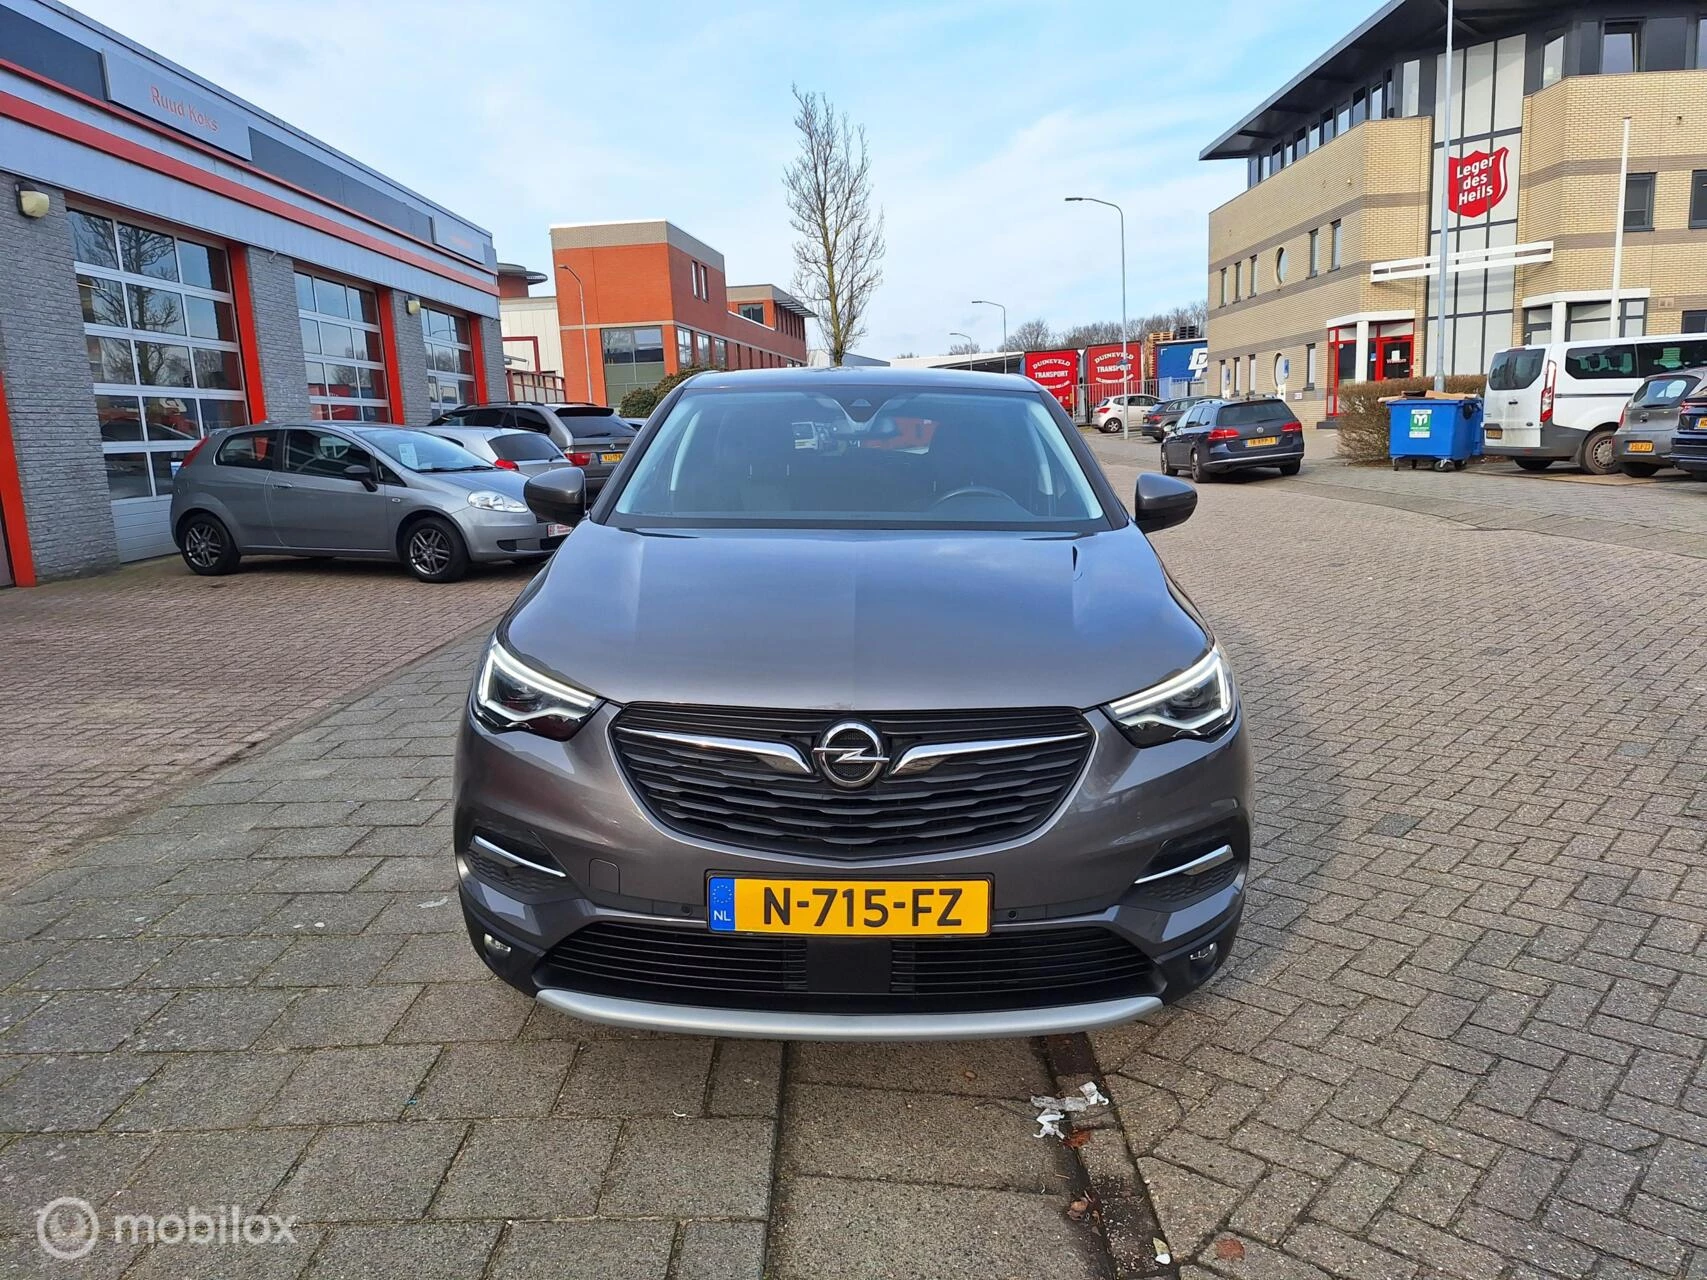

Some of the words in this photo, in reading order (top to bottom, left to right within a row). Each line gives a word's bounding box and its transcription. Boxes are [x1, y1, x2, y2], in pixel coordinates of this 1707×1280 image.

[1456, 156, 1496, 179] Leger
[1463, 173, 1488, 190] des
[1458, 185, 1494, 206] Heils
[1032, 358, 1071, 370] DUINEVELD
[1034, 370, 1069, 379] TRANSPORT
[763, 887, 963, 927] N-715-FZ
[713, 910, 731, 922] NL
